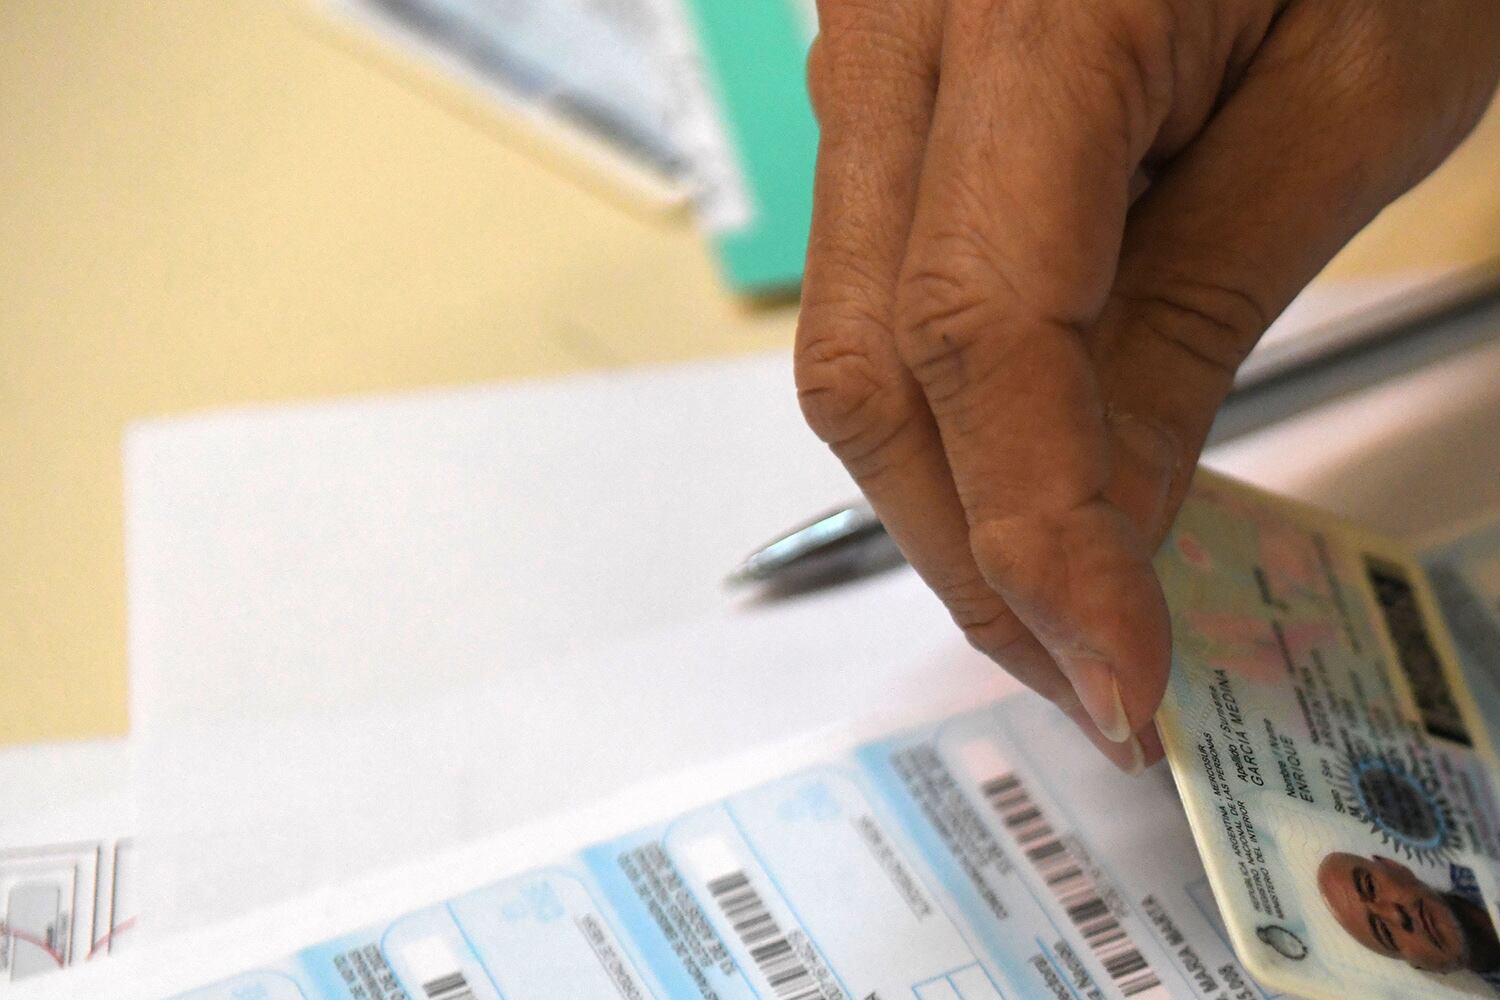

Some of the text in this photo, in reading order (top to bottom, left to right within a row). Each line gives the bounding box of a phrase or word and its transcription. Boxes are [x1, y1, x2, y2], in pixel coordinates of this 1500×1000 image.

[1212, 667, 1264, 786] GARCIA MEDINA
[1203, 731, 1226, 781] PERSONAS
[1279, 734, 1314, 803] ENRIQUE
[1197, 744, 1241, 856] ARGENTINA MERCOSUR
[1220, 784, 1234, 801] LAS
[1226, 802, 1239, 815] DE
[1232, 819, 1255, 864] NACIONAL
[1236, 800, 1258, 843] INTERIOR
[1251, 845, 1265, 863] DEL
[1173, 943, 1224, 993] MARIA
